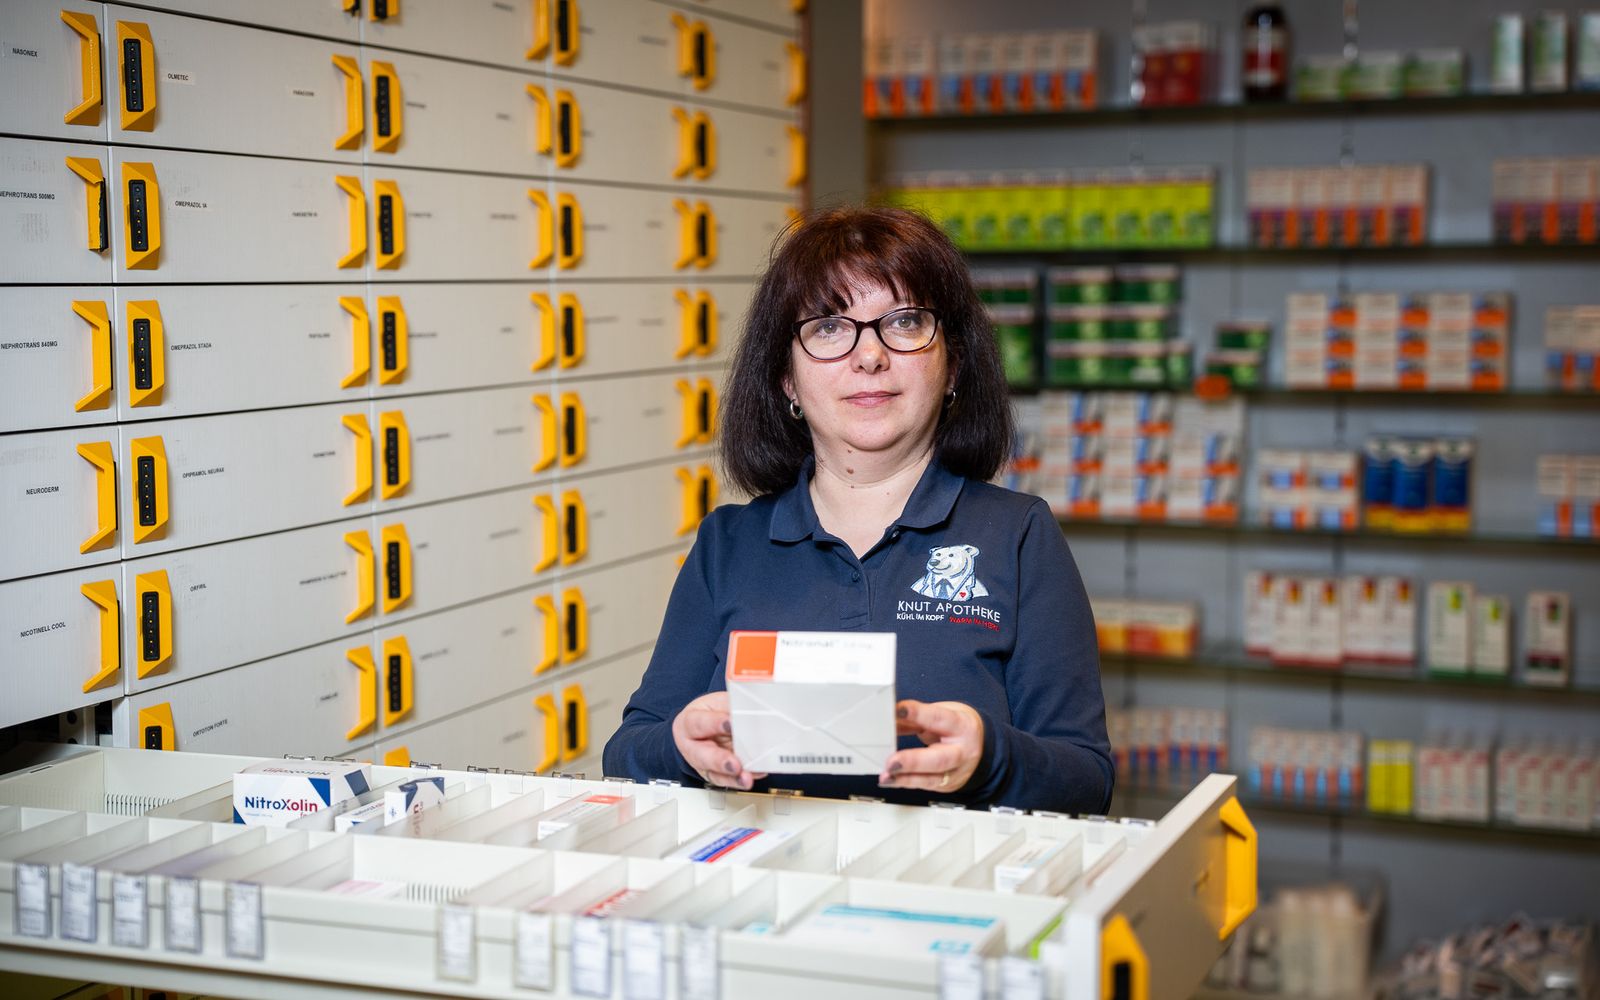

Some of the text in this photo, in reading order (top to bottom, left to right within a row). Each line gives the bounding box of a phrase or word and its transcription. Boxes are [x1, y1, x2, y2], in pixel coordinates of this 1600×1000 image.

[12, 48, 38, 58] NASONEX
[167, 73, 189, 81] OLMETEC
[0, 340, 58, 350] NEPHROTRANS 840MG
[170, 344, 197, 352] OMEPRAZOL
[26, 485, 60, 495] NEURODERM
[896, 612, 915, 621] KÜHL
[897, 600, 1001, 623] KNUT APOTHEKE
[20, 621, 67, 638] NICOTINELL COOL
[244, 796, 319, 813] NitroXolin
